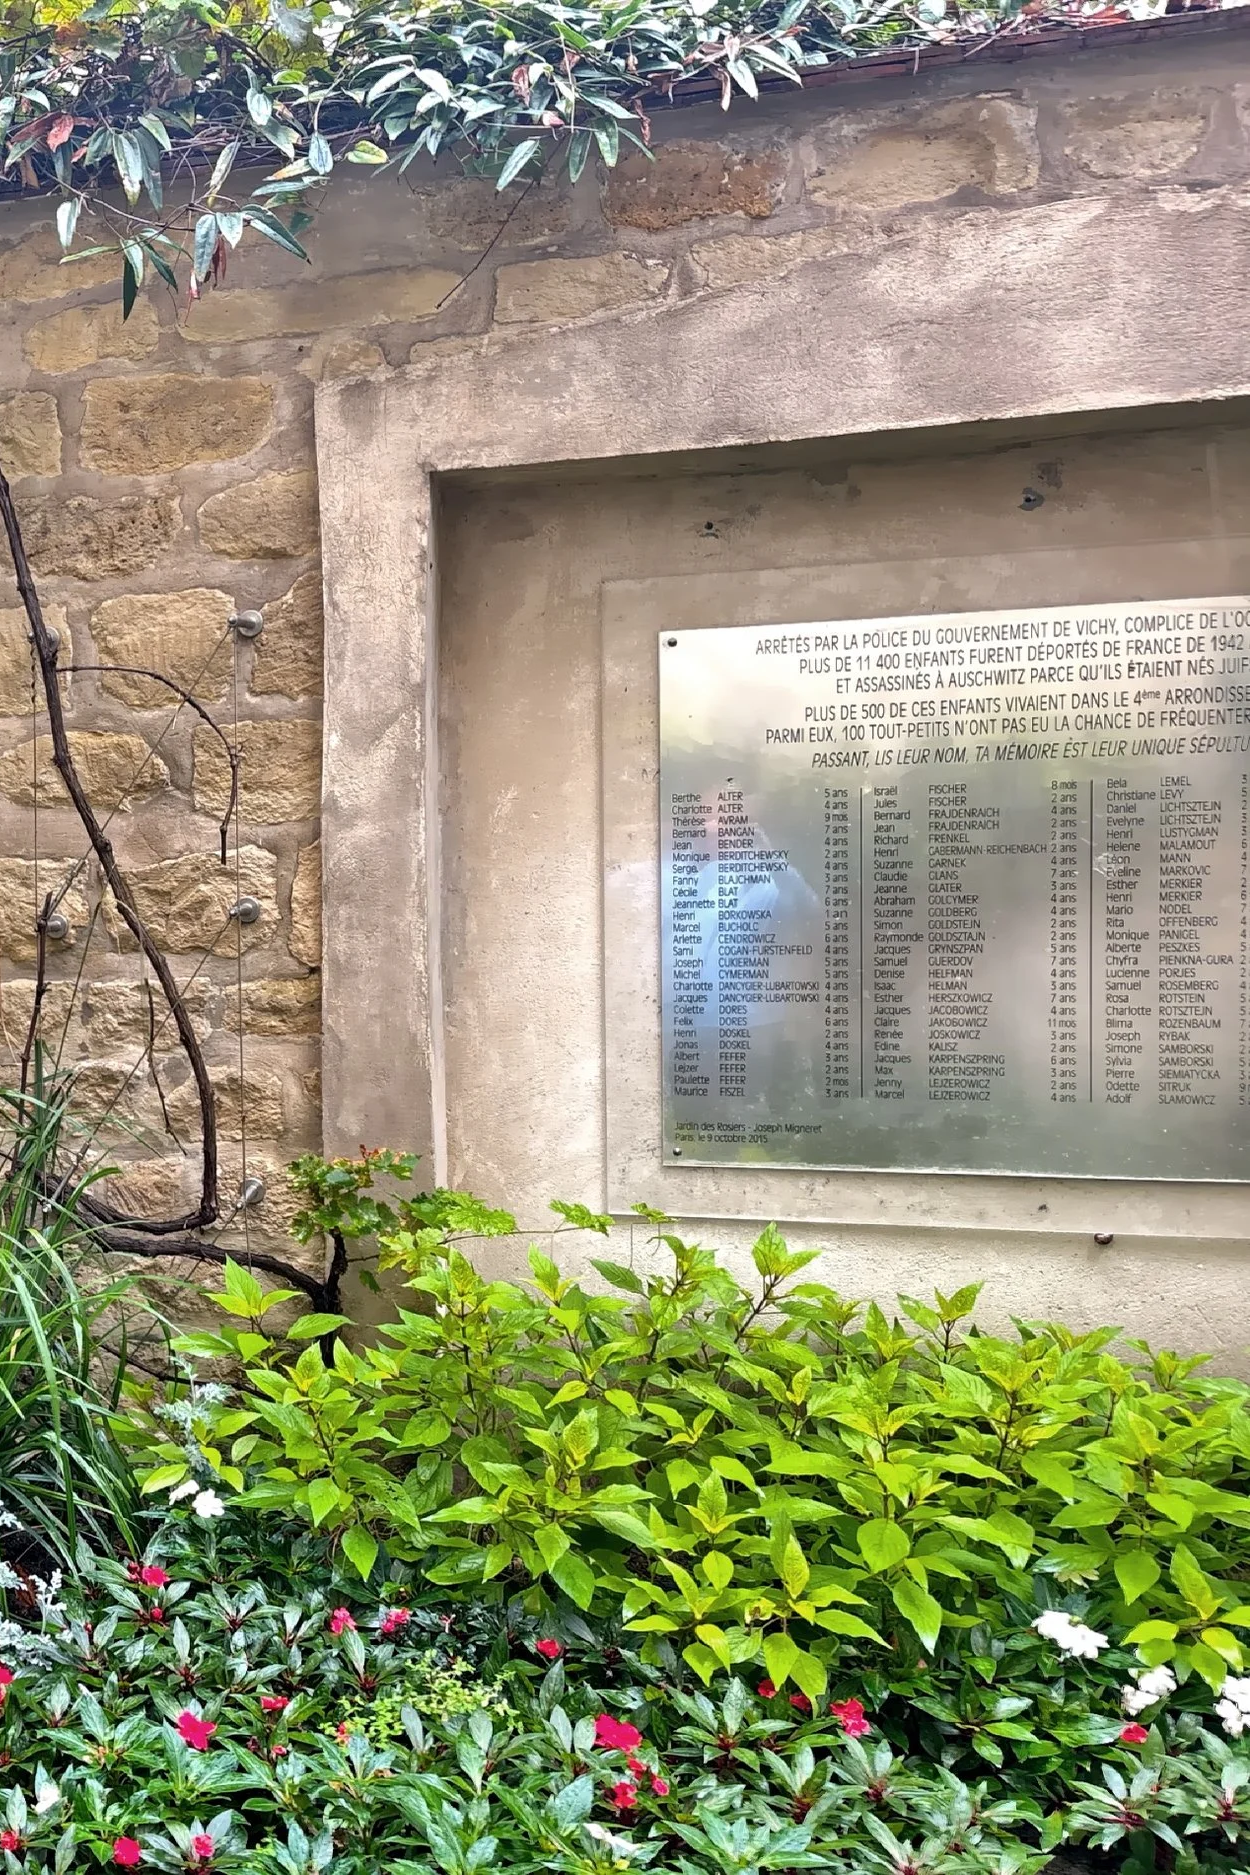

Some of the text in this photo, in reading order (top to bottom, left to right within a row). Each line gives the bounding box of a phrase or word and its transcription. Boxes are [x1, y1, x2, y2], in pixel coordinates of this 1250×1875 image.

[756, 635, 810, 654] ARRÊTÉS
[815, 635, 838, 651] PAR
[844, 634, 858, 650] LA
[863, 631, 907, 648] POLICE
[913, 630, 930, 646] DU
[936, 622, 1048, 644] GOUVERNEMENT
[1054, 621, 1070, 637] DE
[1076, 619, 1118, 635] VICHY,
[1125, 614, 1193, 633] COMPLICE
[1200, 613, 1217, 629] DE
[800, 634, 1243, 674] PLUS DE 11 400 ENFANTS FURENT DÉPORTÉS DE FRANCE DE 1942
[837, 657, 1250, 693] ET ASSASSINÉS À AUSCHWITZ PARCE QU'ILS ÉTAIENT NÉS JUIF
[805, 705, 835, 721] PLUS
[841, 704, 856, 720] DE
[862, 703, 885, 719] 500
[889, 702, 907, 718] DE
[912, 701, 935, 717] CES
[941, 698, 1000, 715] ENFANTS
[1006, 694, 1066, 712] VIVAIENT
[1072, 692, 1108, 709] DANS
[1114, 691, 1128, 707] LE
[1134, 689, 1160, 706] 4ème
[766, 708, 1250, 743] PARMI EUX, 100 TOUT-PETITS N'ONT PAS EU LA CHANCE DE FRÉQUENTER
[812, 751, 869, 768] PASSANT,
[875, 750, 893, 765] LIS
[897, 749, 930, 764] LEUR
[934, 747, 967, 763] NOM,
[976, 746, 988, 761] TA
[995, 743, 1059, 760] MÉMOIRE
[1092, 740, 1127, 757] LEUR
[1132, 738, 1186, 755] UNIQUE
